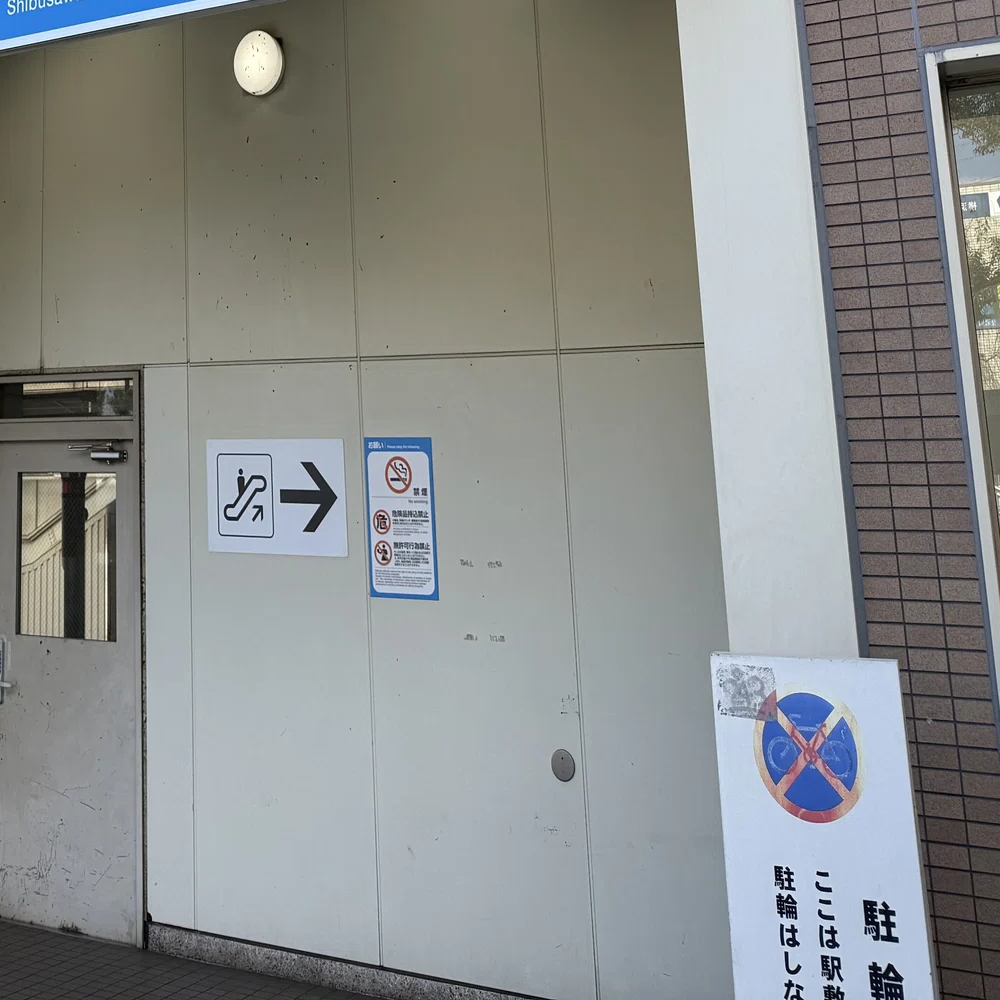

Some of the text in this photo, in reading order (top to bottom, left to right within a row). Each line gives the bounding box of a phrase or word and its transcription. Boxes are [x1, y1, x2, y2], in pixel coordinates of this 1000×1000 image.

[413, 487, 428, 496] 禁煙
[773, 865, 804, 1000] 駐輪はしな
[862, 899, 904, 1000] 駐輪
